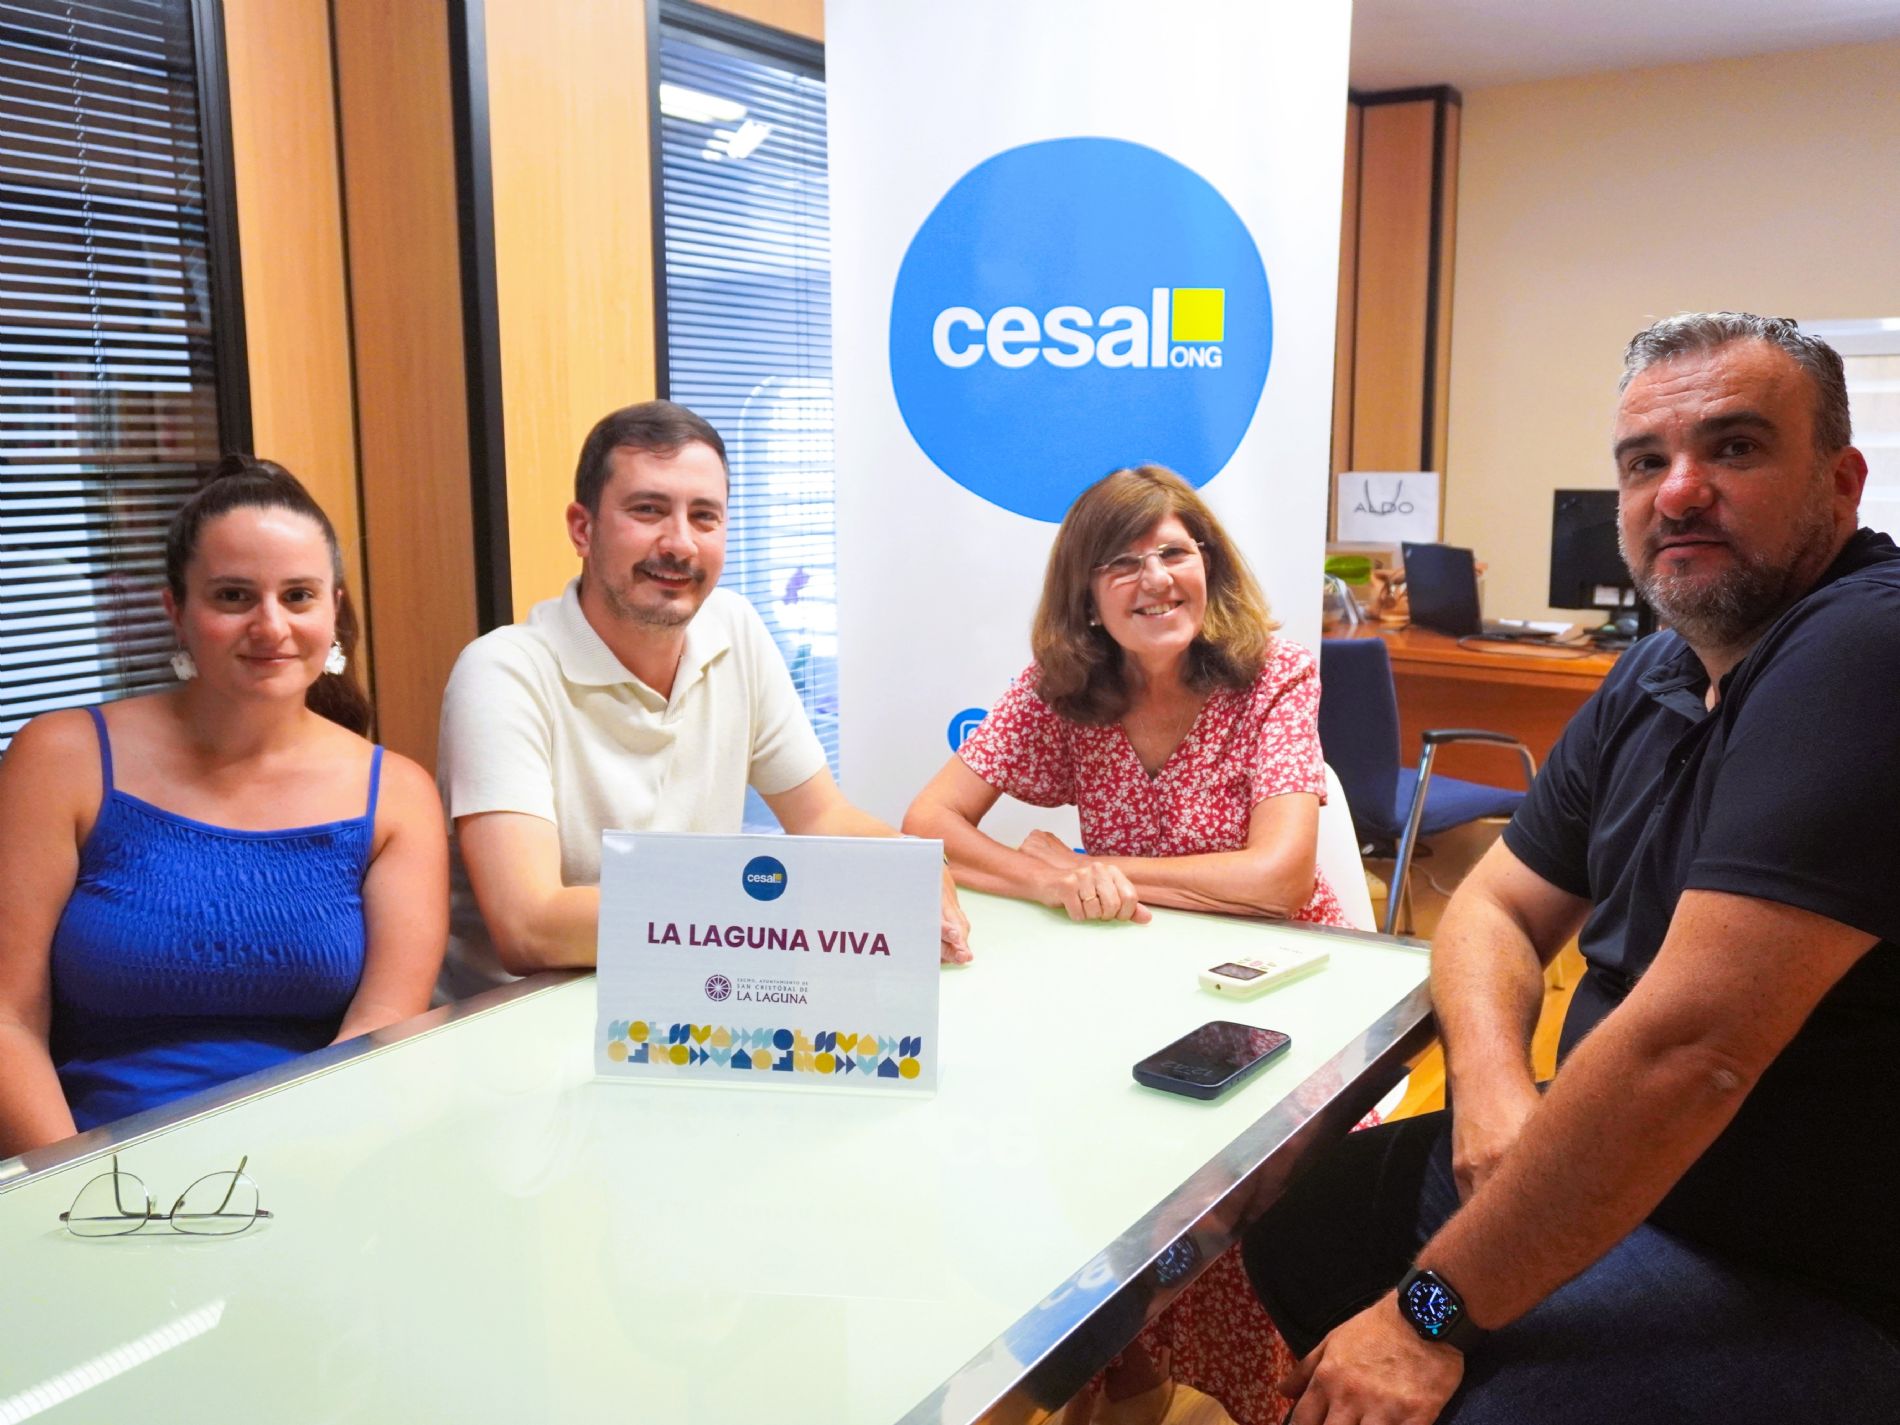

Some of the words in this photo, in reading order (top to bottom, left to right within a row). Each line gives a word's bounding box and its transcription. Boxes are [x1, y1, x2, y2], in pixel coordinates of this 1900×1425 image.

[932, 287, 1169, 368] cesal
[1170, 346, 1223, 368] ONG
[747, 873, 776, 884] cesal
[647, 921, 681, 945] LA
[689, 923, 810, 952] LAGUNA
[817, 929, 891, 956] VIVA
[737, 991, 752, 1001] LA
[756, 992, 808, 1004] LAGUNA
